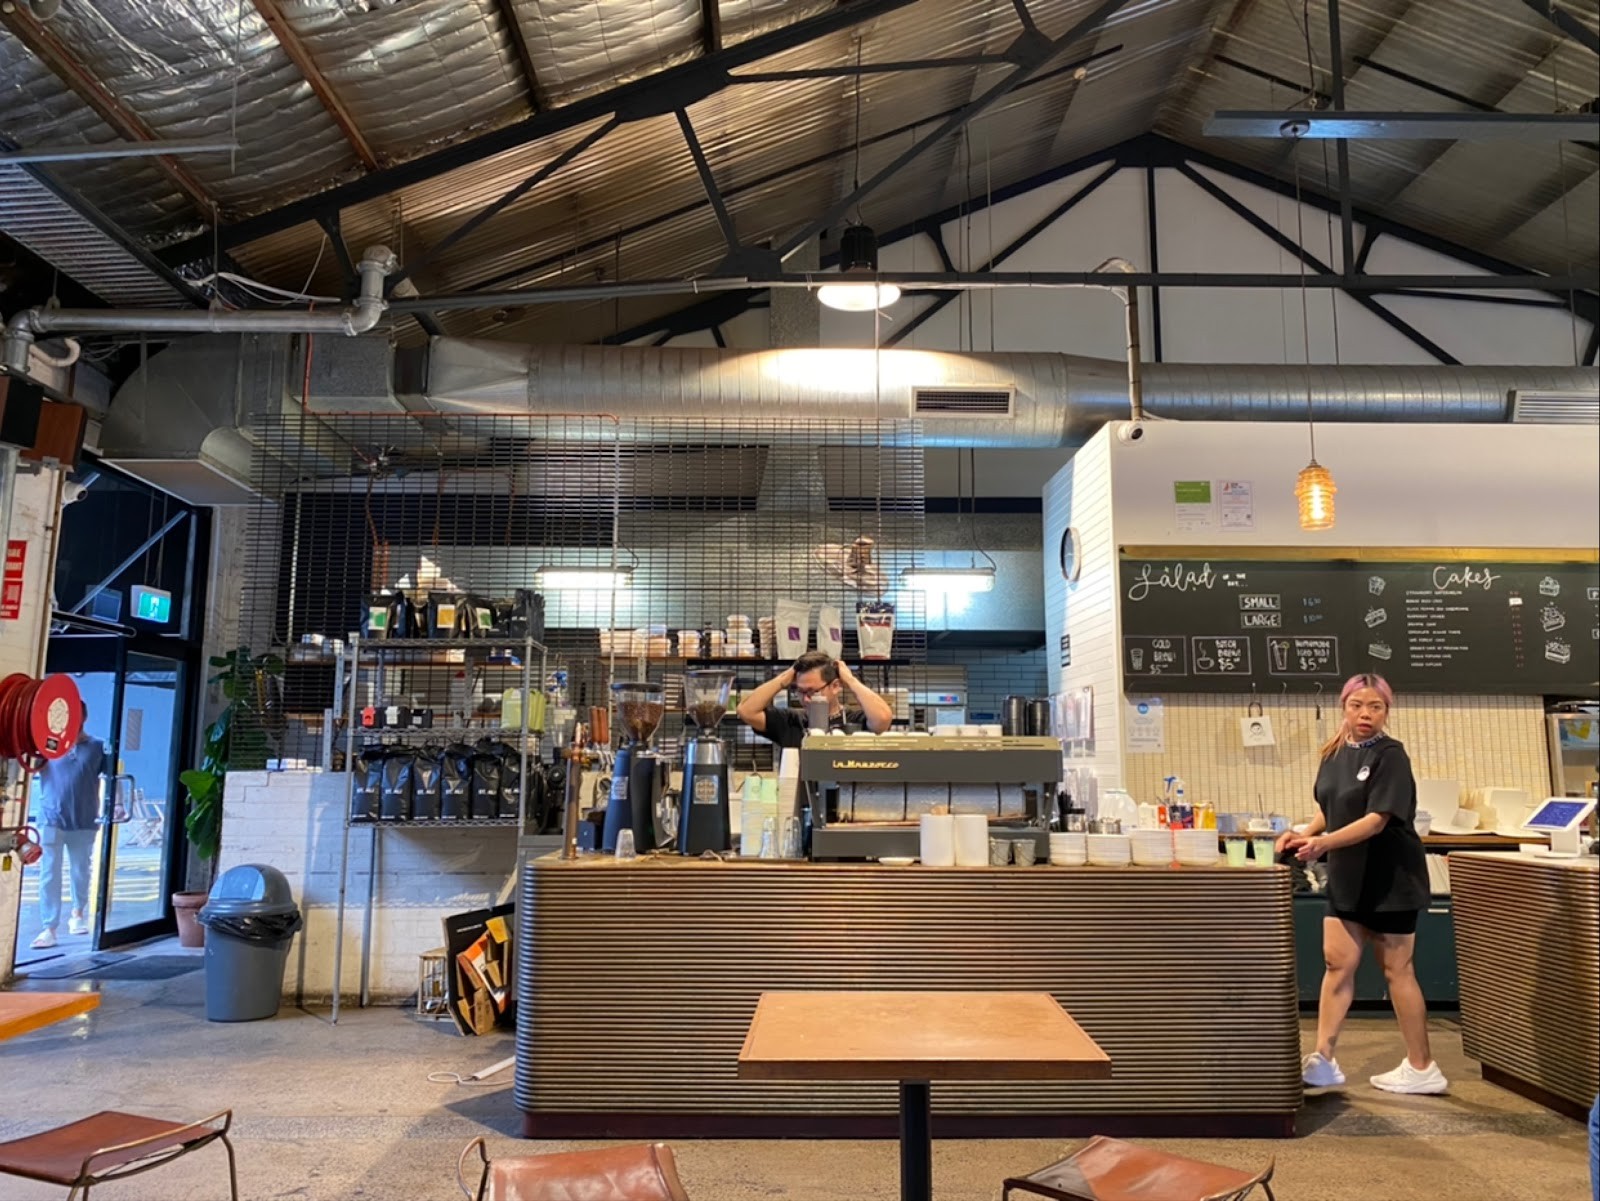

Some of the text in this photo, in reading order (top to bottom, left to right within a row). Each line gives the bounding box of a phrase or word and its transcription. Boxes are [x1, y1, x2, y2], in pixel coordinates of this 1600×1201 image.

[1128, 563, 1217, 600] Salad
[1432, 566, 1502, 590] Cakes
[1244, 597, 1277, 609] SMALL
[1244, 614, 1278, 627] LARGE
